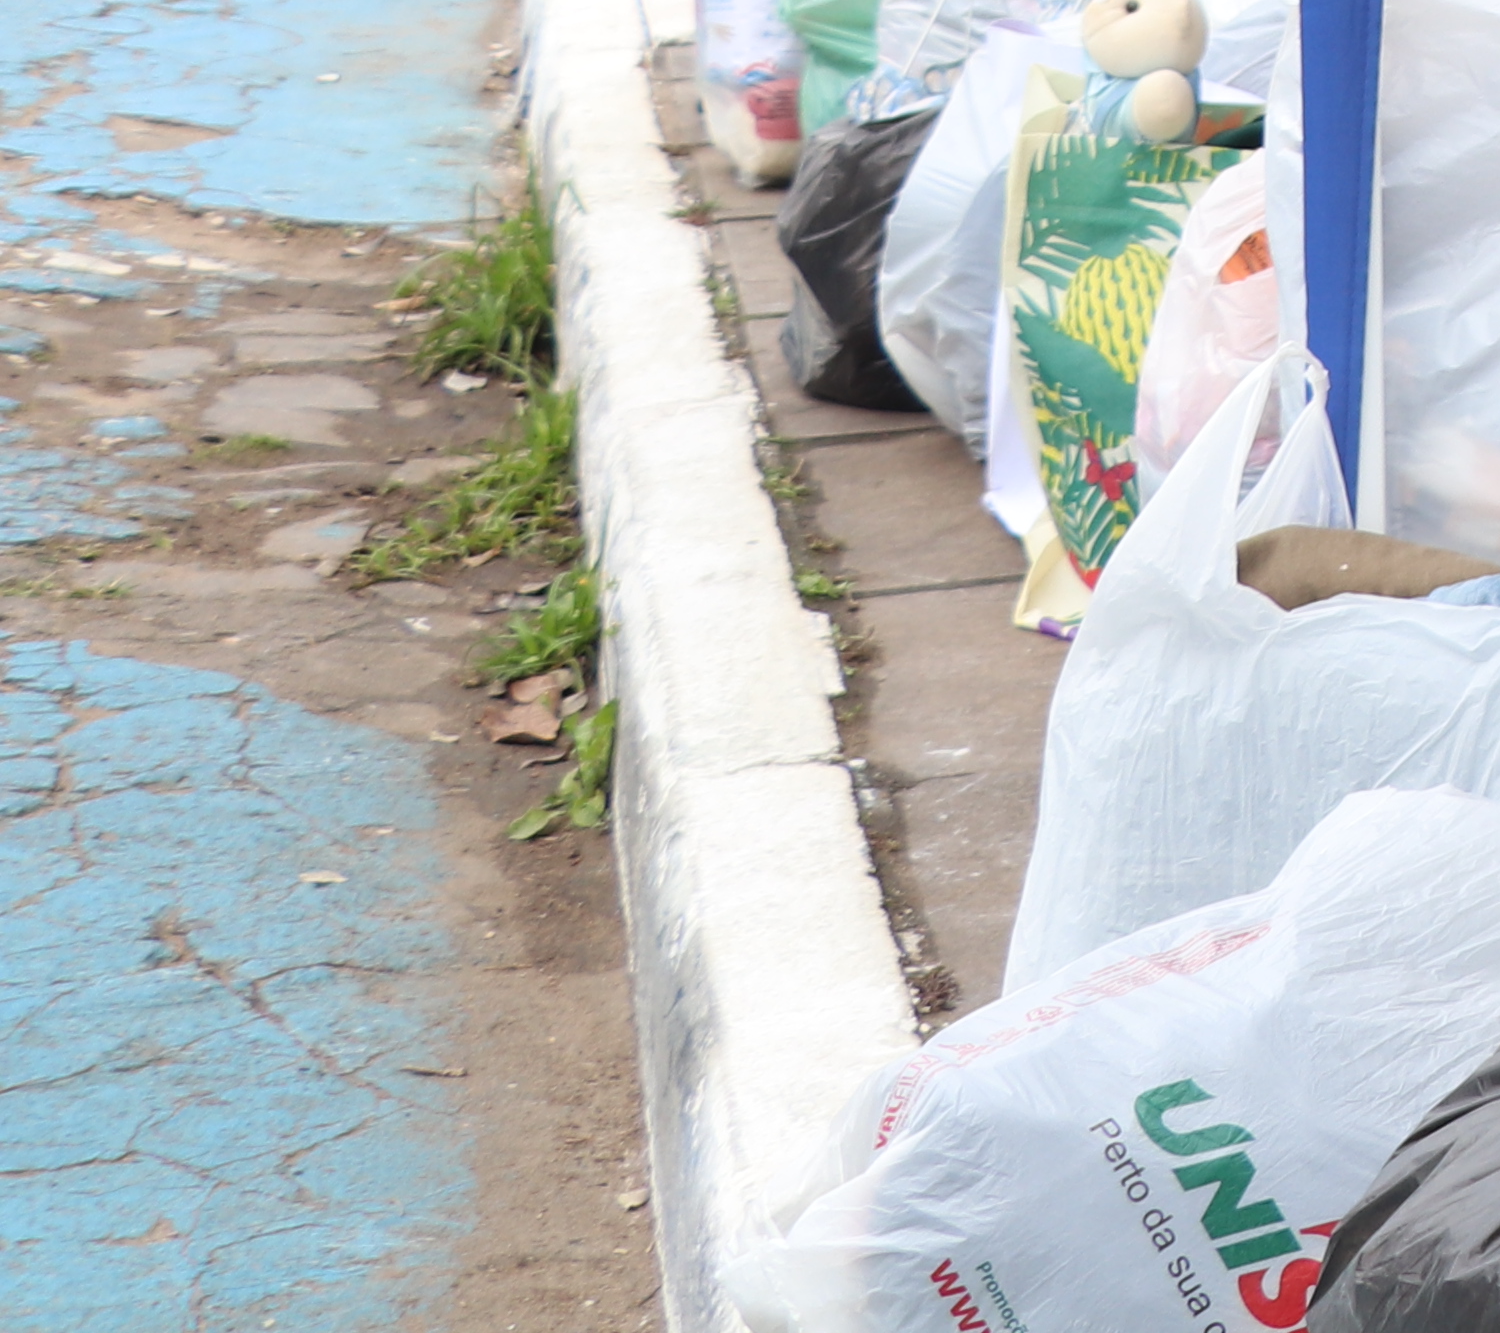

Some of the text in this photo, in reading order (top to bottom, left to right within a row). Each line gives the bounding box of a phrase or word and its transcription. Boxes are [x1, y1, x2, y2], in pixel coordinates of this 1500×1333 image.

[1089, 1117, 1149, 1203] Perto
[1142, 1207, 1176, 1252] da
[1168, 1255, 1211, 1317] sua
